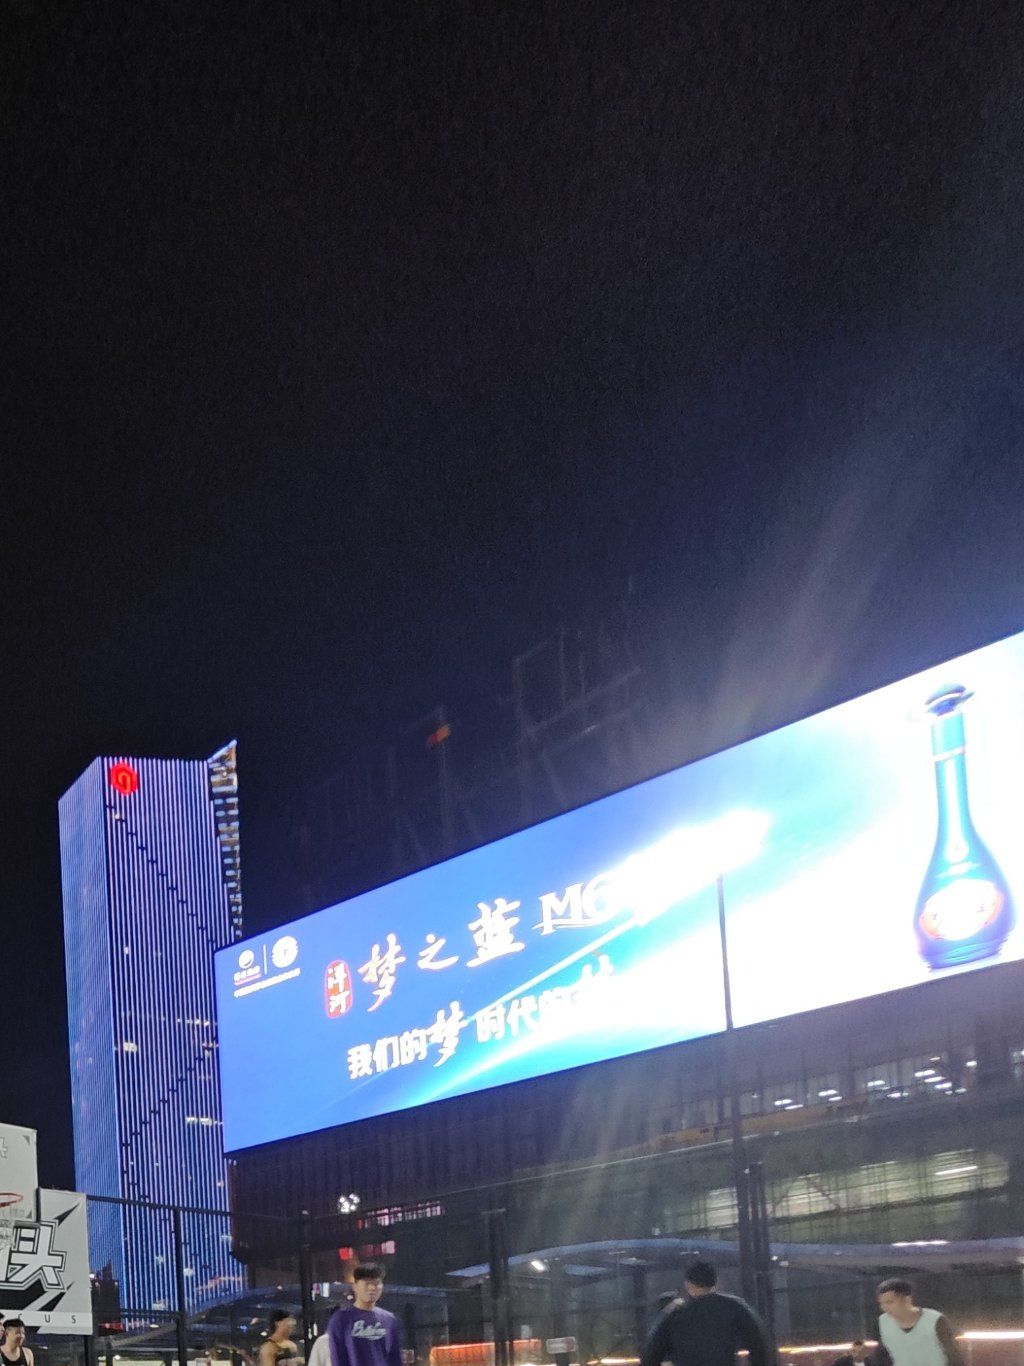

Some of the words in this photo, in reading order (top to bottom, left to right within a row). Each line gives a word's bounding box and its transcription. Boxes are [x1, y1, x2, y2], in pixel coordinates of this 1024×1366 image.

[358, 897, 525, 1012] 梦之蓝
[347, 1001, 468, 1079] 我们的梦
